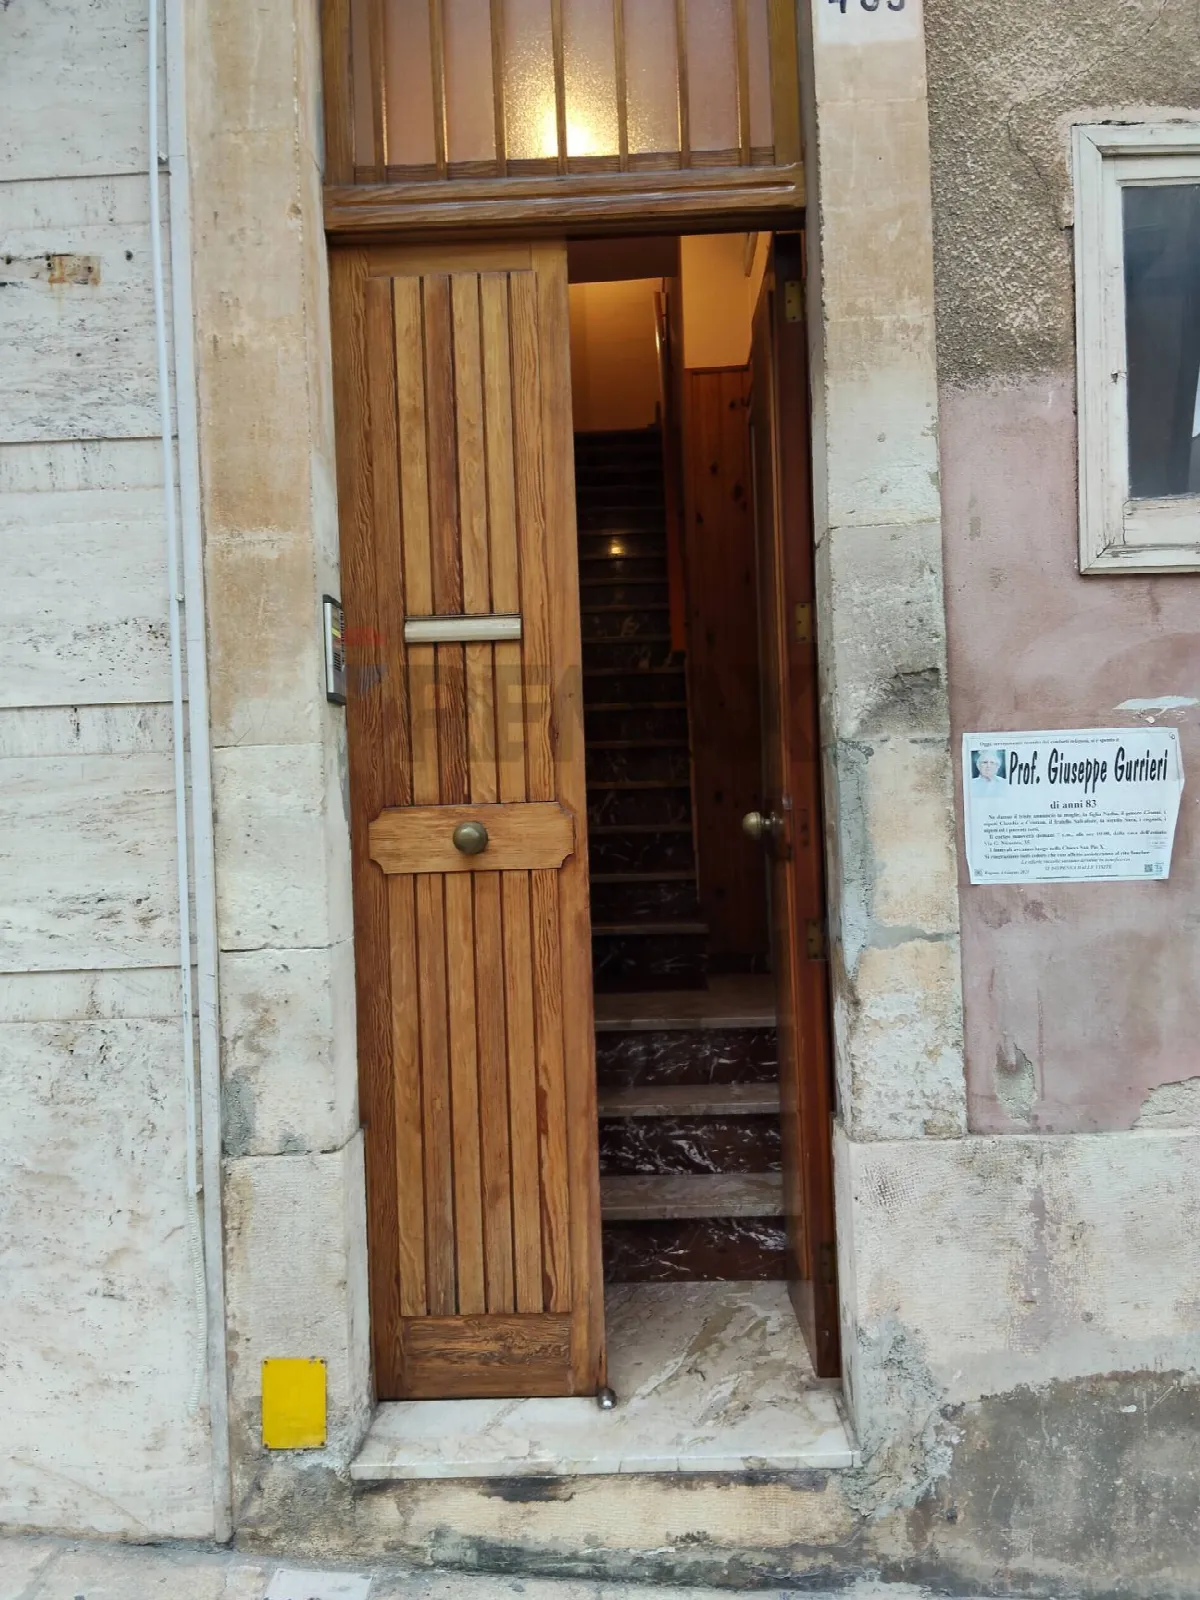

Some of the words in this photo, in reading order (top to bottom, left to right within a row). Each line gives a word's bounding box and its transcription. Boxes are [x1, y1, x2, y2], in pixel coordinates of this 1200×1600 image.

[1009, 751, 1041, 785] Prof.
[1047, 747, 1107, 794] Giuseppe
[1113, 746, 1168, 783] Gurrieri
[1050, 801, 1060, 809] di
[1062, 800, 1083, 809] anni
[1085, 799, 1097, 808] 83
